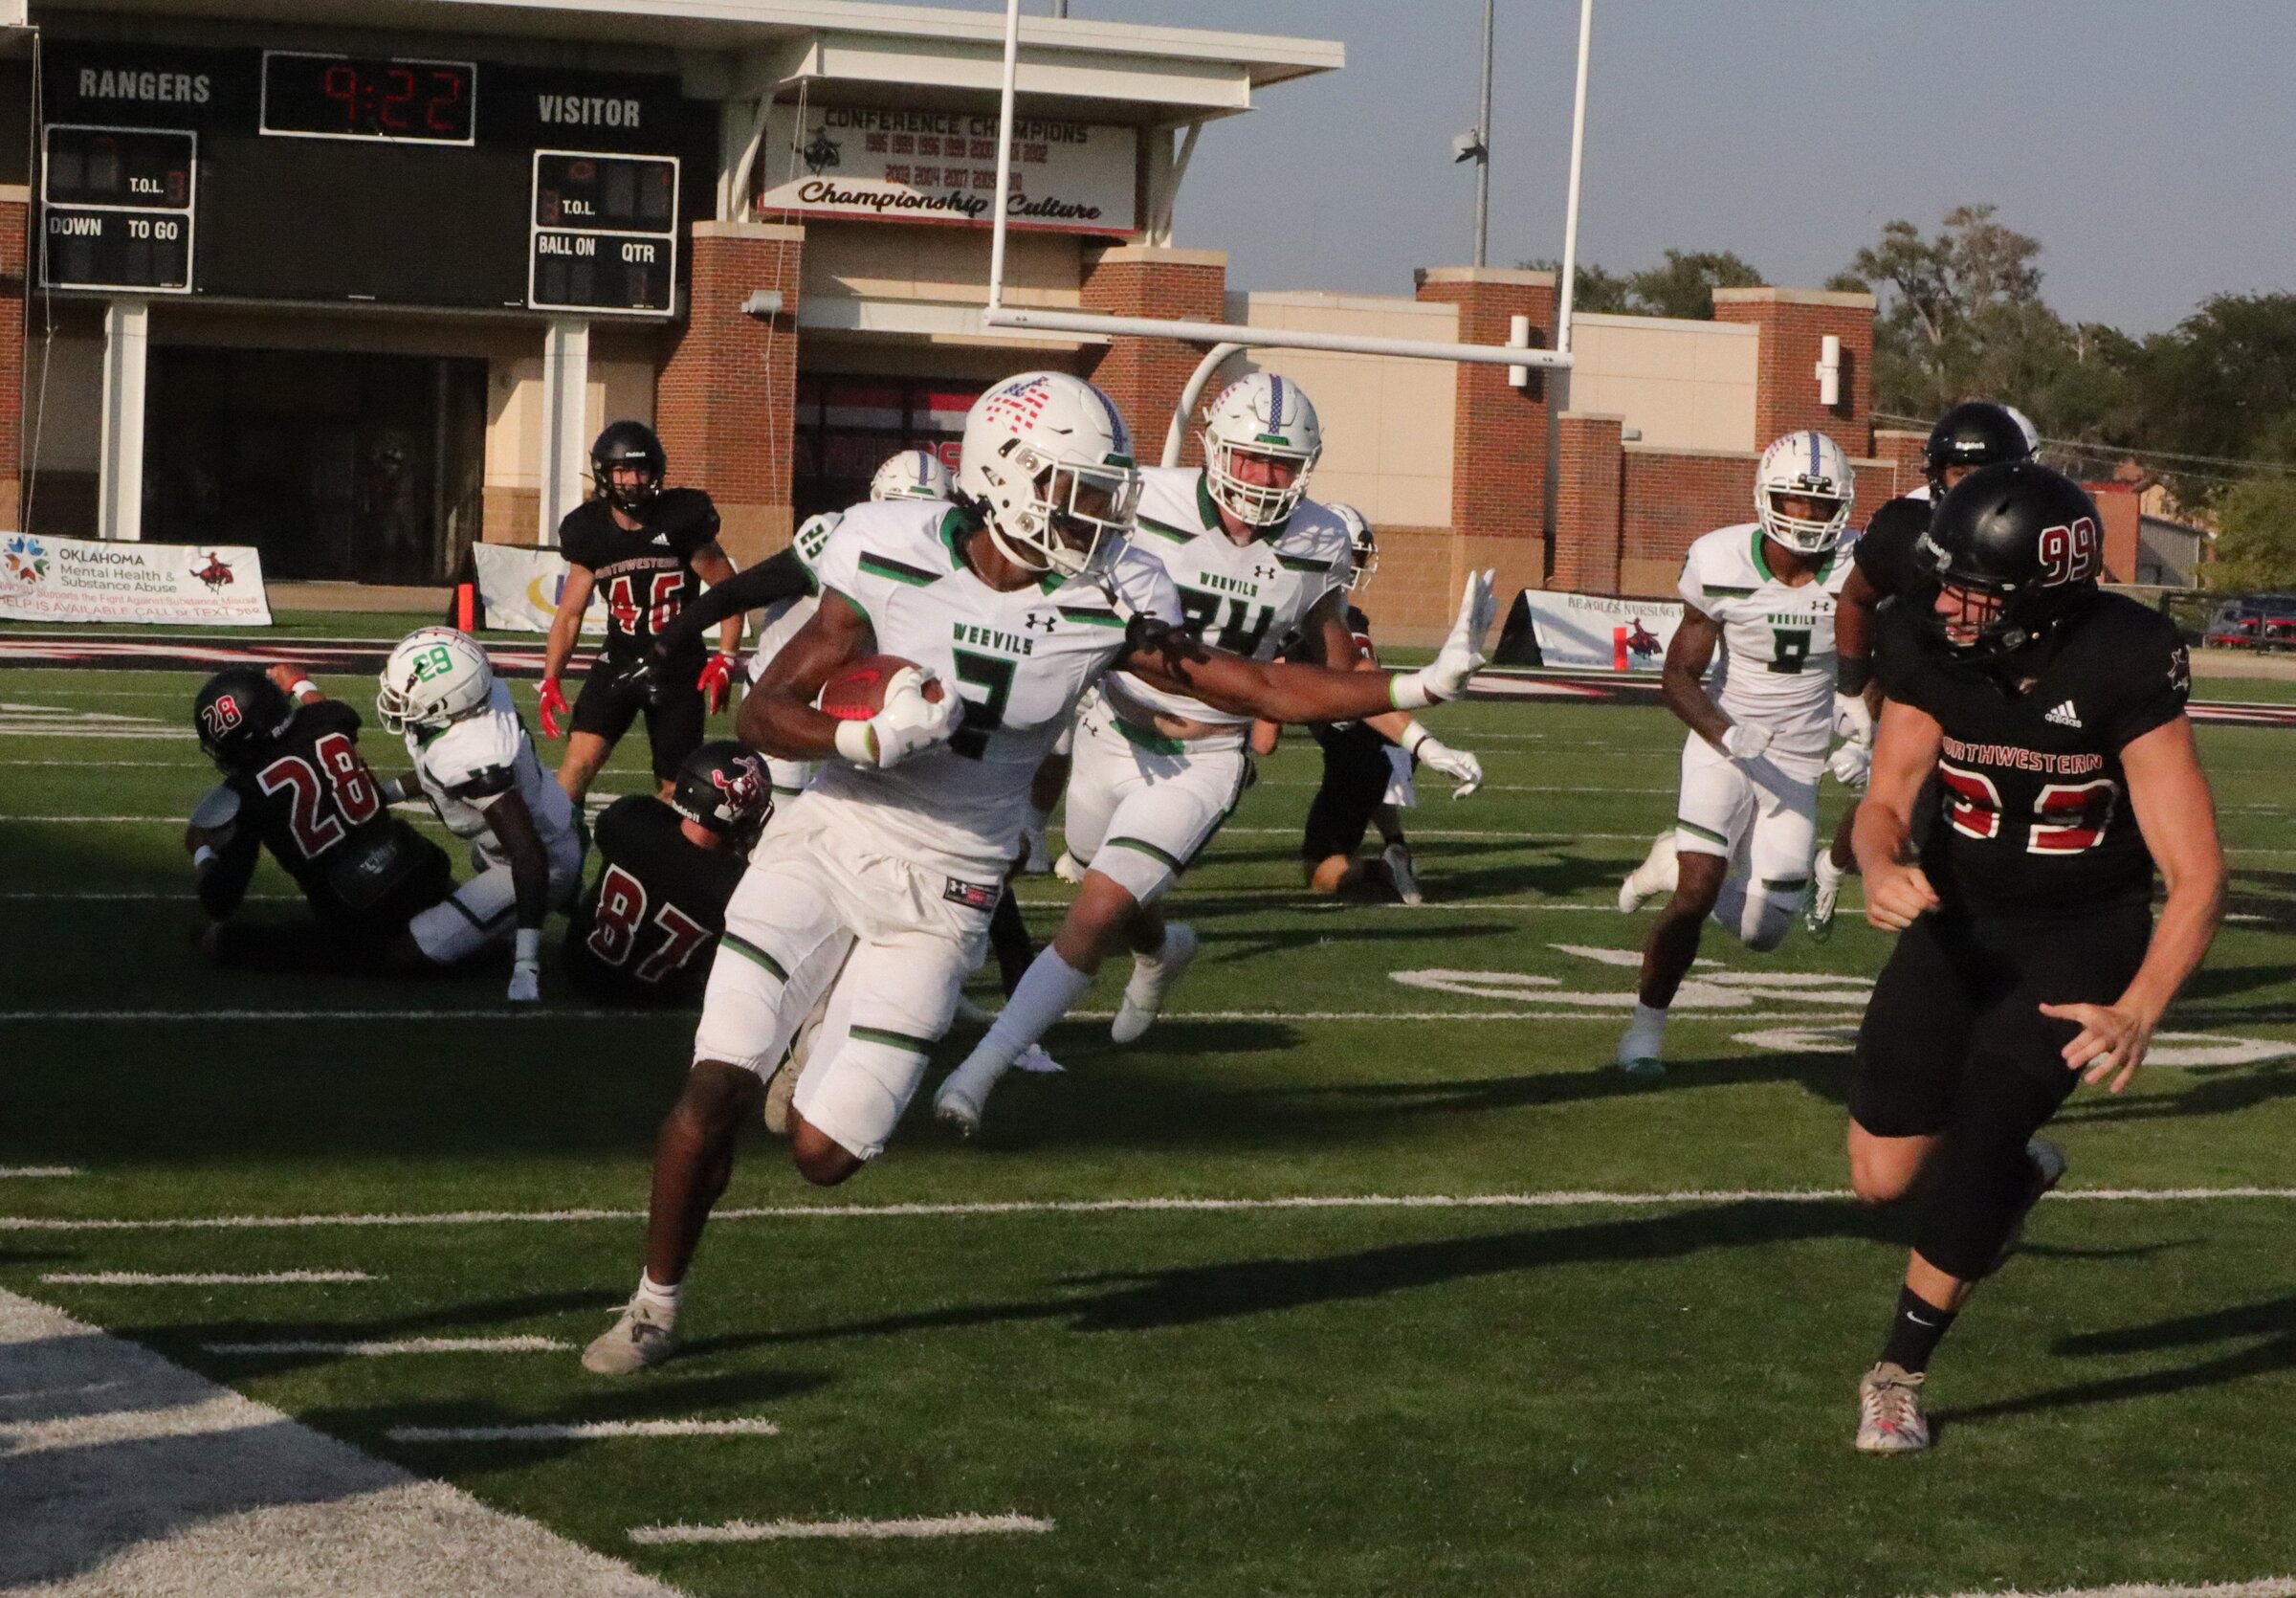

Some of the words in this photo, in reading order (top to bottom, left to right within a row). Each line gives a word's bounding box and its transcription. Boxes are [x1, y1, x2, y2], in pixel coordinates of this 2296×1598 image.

[79, 68, 210, 103] RANGERS
[323, 66, 460, 131] 9:22
[538, 95, 640, 128] VISITOR
[825, 108, 960, 135] CONFERENCE
[970, 118, 1088, 143] CHMPIONS
[130, 177, 165, 194] T.O.L.
[563, 200, 596, 215] T.O.L.
[798, 181, 988, 218] Championship
[1005, 193, 1101, 220] Culture
[50, 217, 102, 236] DOWN
[128, 219, 149, 238] TO
[154, 222, 179, 240] GO
[539, 234, 573, 255] BALL
[576, 237, 596, 256] ON
[622, 243, 655, 263] QTR
[59, 548, 145, 566] OKLAHOMA
[2039, 517, 2097, 588] 99
[60, 564, 109, 579] Mental
[114, 568, 161, 581] Health
[166, 572, 175, 583] &
[60, 577, 131, 592] Substance
[134, 580, 178, 594] Abuse
[1200, 571, 1259, 598] WEEVILS
[36, 601, 50, 612] IS
[54, 603, 128, 615] AVAILABLE
[135, 608, 168, 617] CALL
[193, 607, 230, 617] TEXT
[99, 593, 124, 605] Fight
[608, 570, 685, 635] 46
[1624, 603, 1675, 618] NURSING
[954, 622, 1034, 656] WEEVILS
[412, 646, 453, 683] 29
[201, 695, 243, 741] 28
[2044, 713, 2082, 728] adidas
[255, 732, 381, 859] 28
[587, 862, 715, 983] 87
